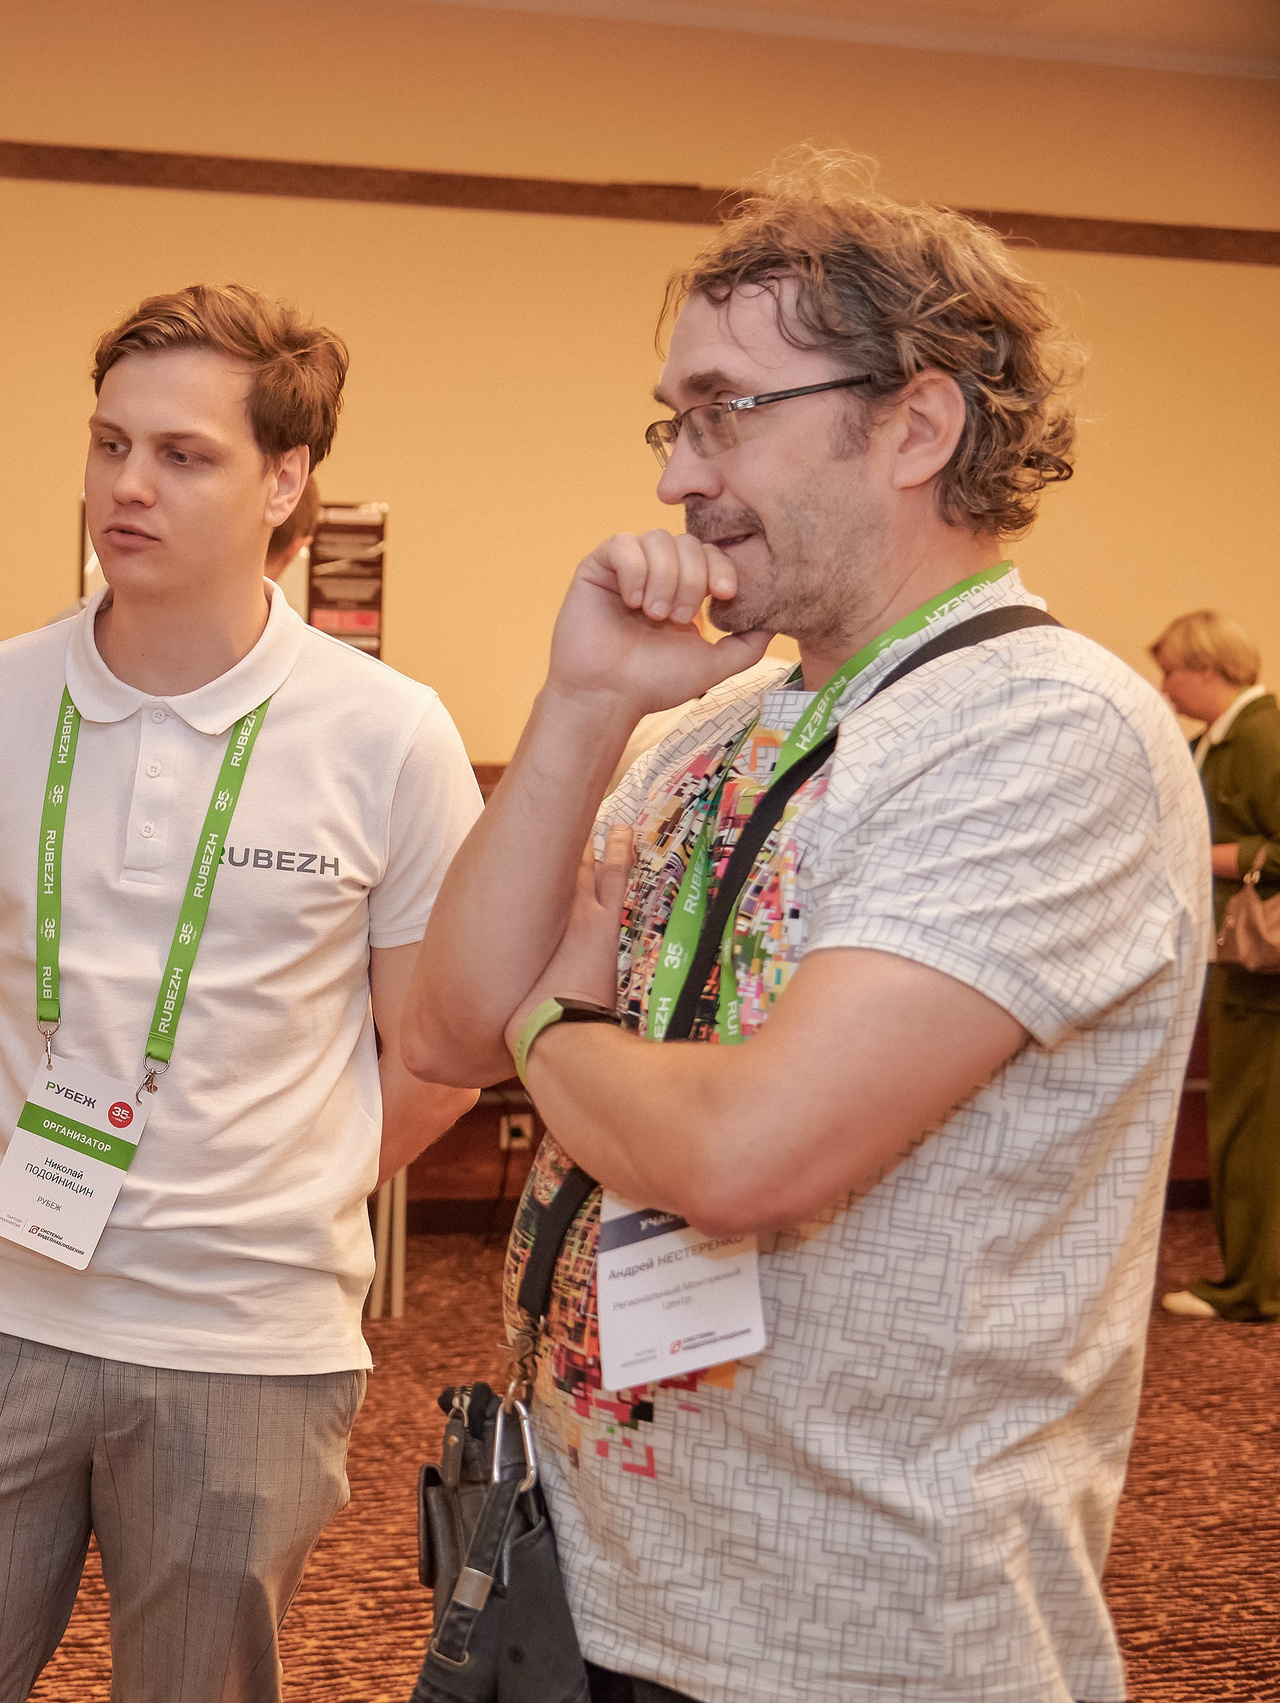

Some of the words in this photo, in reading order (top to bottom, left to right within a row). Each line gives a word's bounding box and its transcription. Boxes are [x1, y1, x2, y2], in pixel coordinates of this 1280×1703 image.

[795, 676, 847, 751] RUBEZH
[57, 705, 75, 764] RUBEZH
[230, 708, 259, 768] RUBEZH
[52, 784, 64, 804] 35
[215, 790, 230, 812] 35
[44, 830, 57, 895] RUBEZH
[193, 832, 219, 898] RUBEZH
[44, 918, 56, 939] 35
[178, 922, 194, 945] 35
[664, 942, 684, 969] 35
[42, 966, 53, 1000] RUB
[158, 967, 183, 1034] RUBEZH
[653, 997, 672, 1041] EZH
[45, 1081, 97, 1109] РУБЕЖ
[112, 1106, 130, 1120] 35
[43, 1119, 112, 1152] ОРГАНИЗАТОР
[25, 1162, 94, 1198] ПОДОЙНИЦИН
[44, 1157, 84, 1180] Николай
[36, 1196, 62, 1212] РУБЕЖ
[39, 1227, 64, 1241] СИСТЕМЫ
[639, 1213, 679, 1231] УЧАС
[607, 1258, 654, 1281] Андрей
[656, 1234, 744, 1266] НЕСТЕРЕНКО
